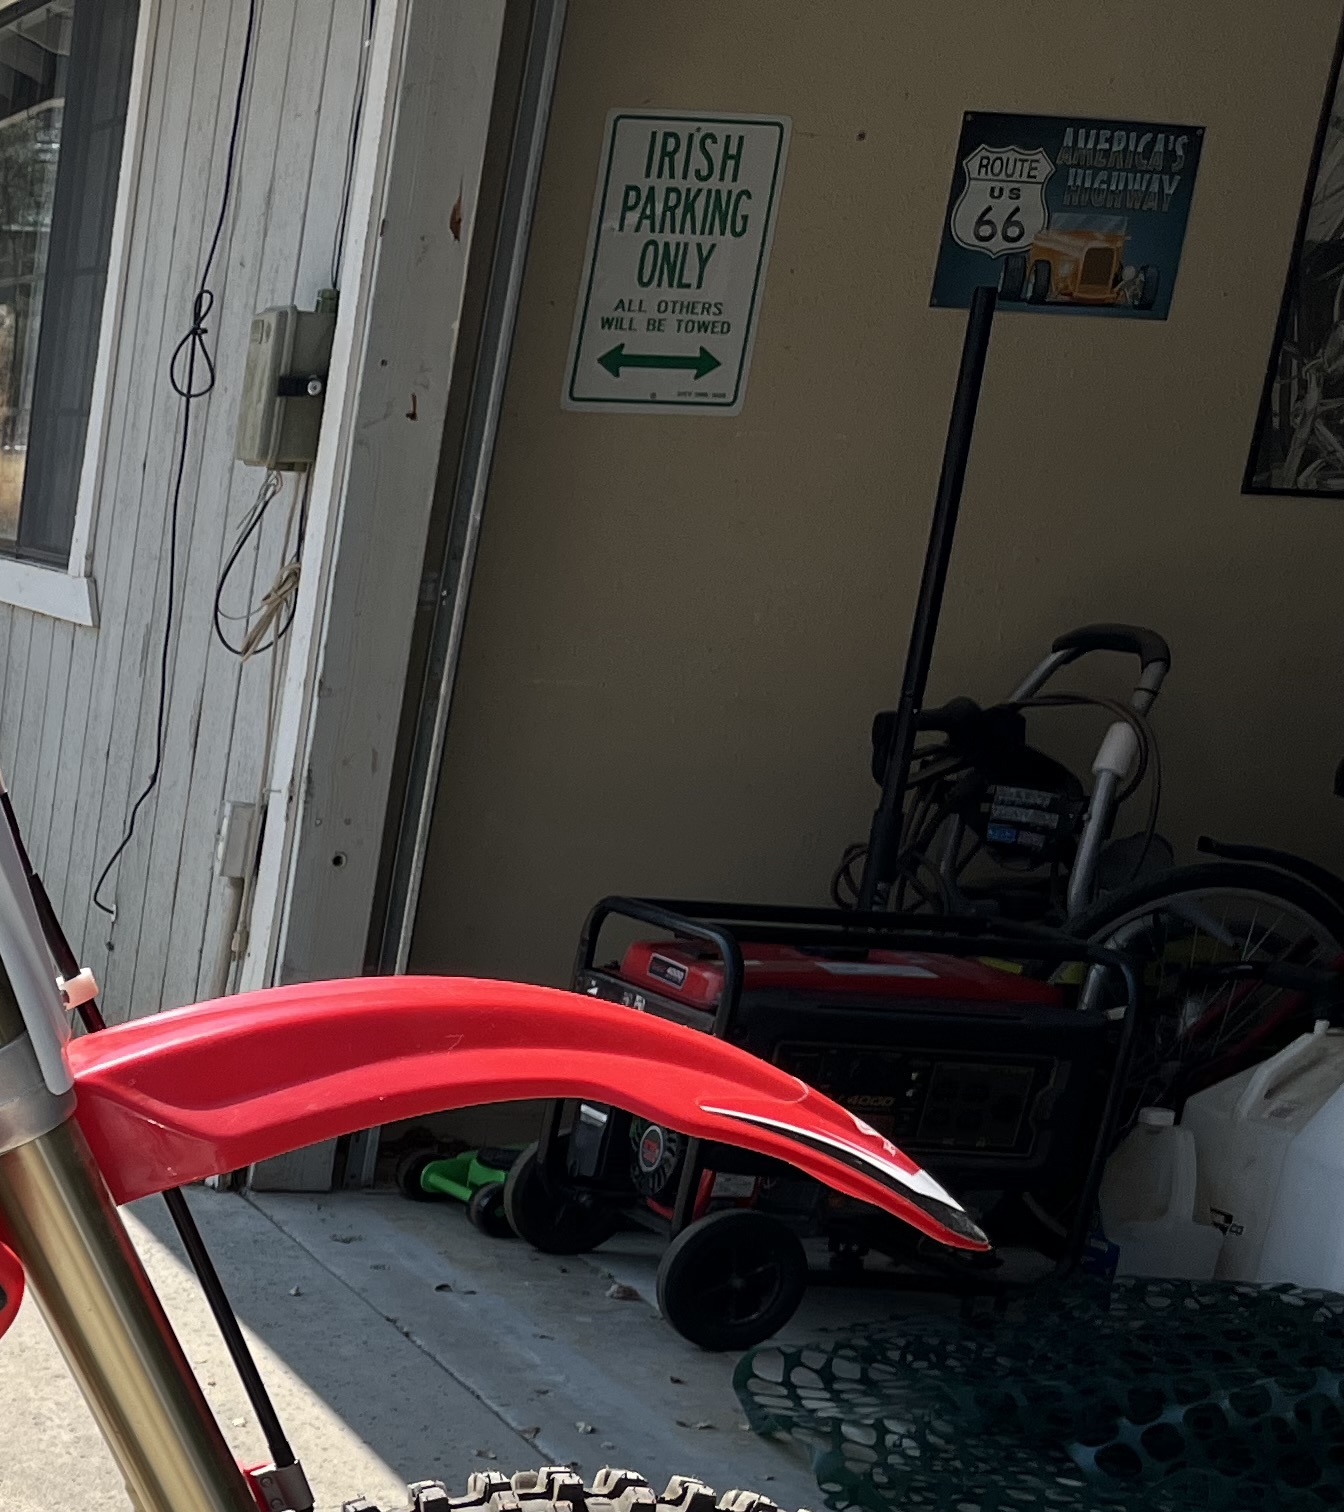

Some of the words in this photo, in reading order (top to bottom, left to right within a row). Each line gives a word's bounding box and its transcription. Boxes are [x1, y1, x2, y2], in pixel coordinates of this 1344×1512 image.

[644, 130, 745, 182] IRISH
[977, 155, 1041, 180] ROUTE
[1056, 127, 1190, 173] AMERICA'S
[618, 184, 753, 238] PARKING
[988, 185, 1022, 201] US
[1063, 167, 1181, 213] HIGHWAY
[972, 205, 1025, 244] 66
[637, 238, 717, 290] ONLY
[600, 316, 637, 332] WILL
[646, 317, 666, 333] BE
[675, 318, 732, 336] TOWED
[613, 298, 647, 314] ALL
[656, 300, 724, 317] OTHERS
